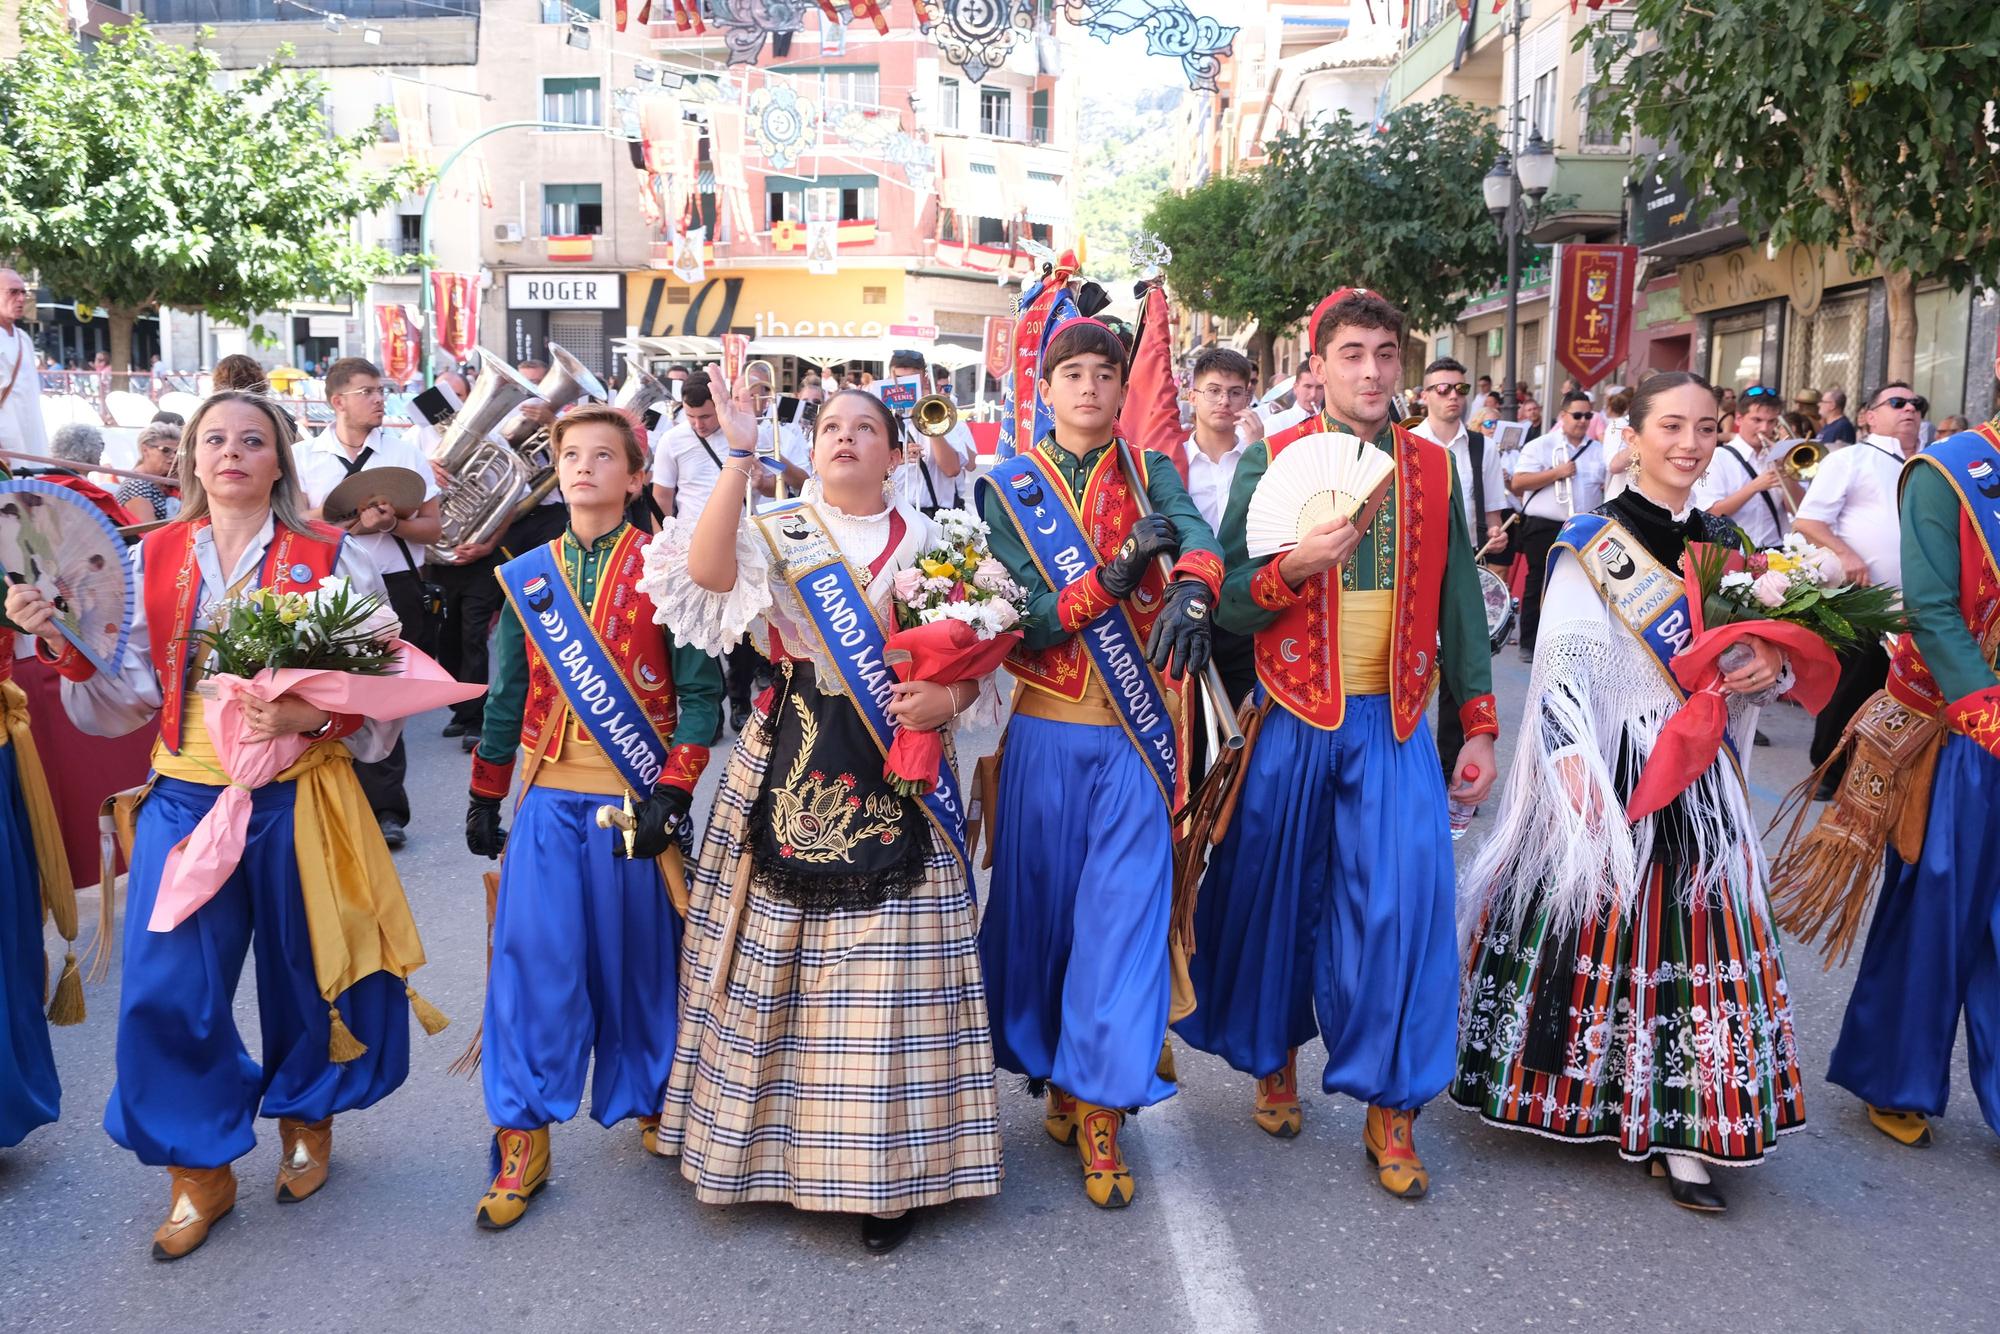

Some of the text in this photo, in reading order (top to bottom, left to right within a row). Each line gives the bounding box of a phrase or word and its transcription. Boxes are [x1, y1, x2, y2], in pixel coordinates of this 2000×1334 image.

[527, 281, 598, 301] ROGER
[811, 573, 866, 647] BANDO
[1619, 571, 1662, 609] MADRINA
[1636, 587, 1670, 618] MAYOR
[1093, 618, 1160, 733] MARROQUI
[558, 639, 663, 794] BANDO MARRO
